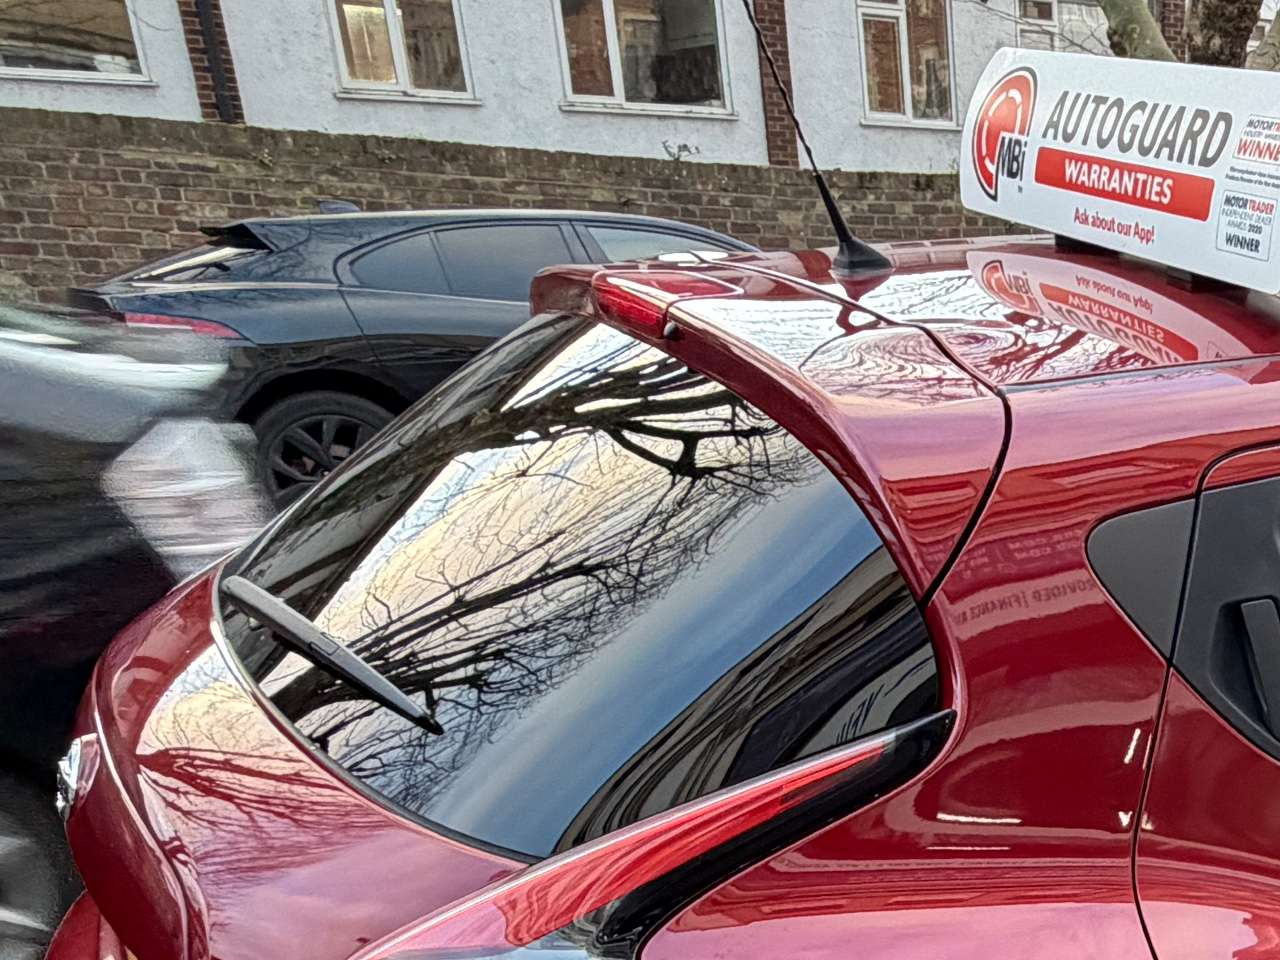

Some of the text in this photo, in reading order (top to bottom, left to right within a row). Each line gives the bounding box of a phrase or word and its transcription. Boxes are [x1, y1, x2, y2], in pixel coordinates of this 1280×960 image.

[1041, 90, 1233, 168] AUTOGUARD
[1064, 157, 1174, 205] WARRANTIES
[1073, 207, 1156, 246] Ask about our App!
[1225, 231, 1261, 253] WINNER
